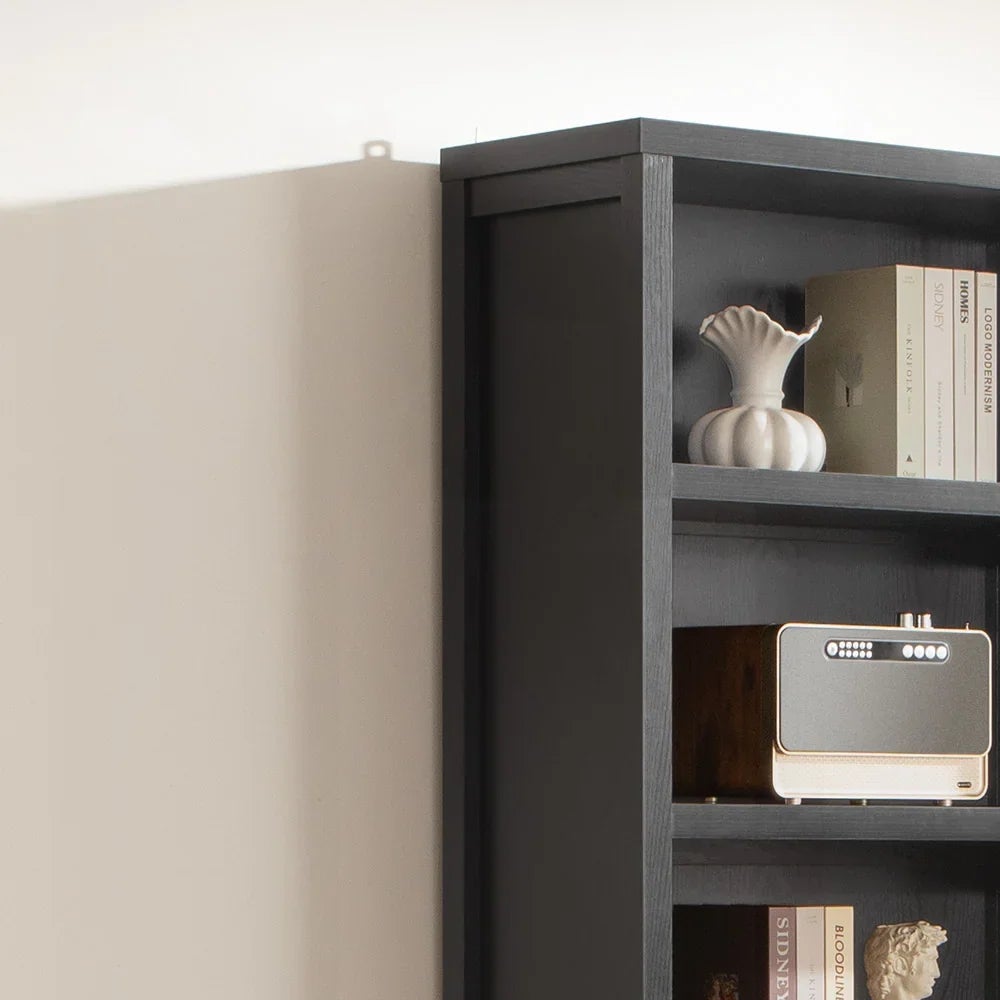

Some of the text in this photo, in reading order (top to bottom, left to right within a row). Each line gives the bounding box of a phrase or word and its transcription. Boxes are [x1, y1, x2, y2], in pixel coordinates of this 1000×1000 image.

[934, 282, 945, 332] SIDNEY
[960, 280, 969, 324] HOMES
[905, 338, 913, 394] KINFOLK
[984, 307, 993, 414] LOGO MODERNISM
